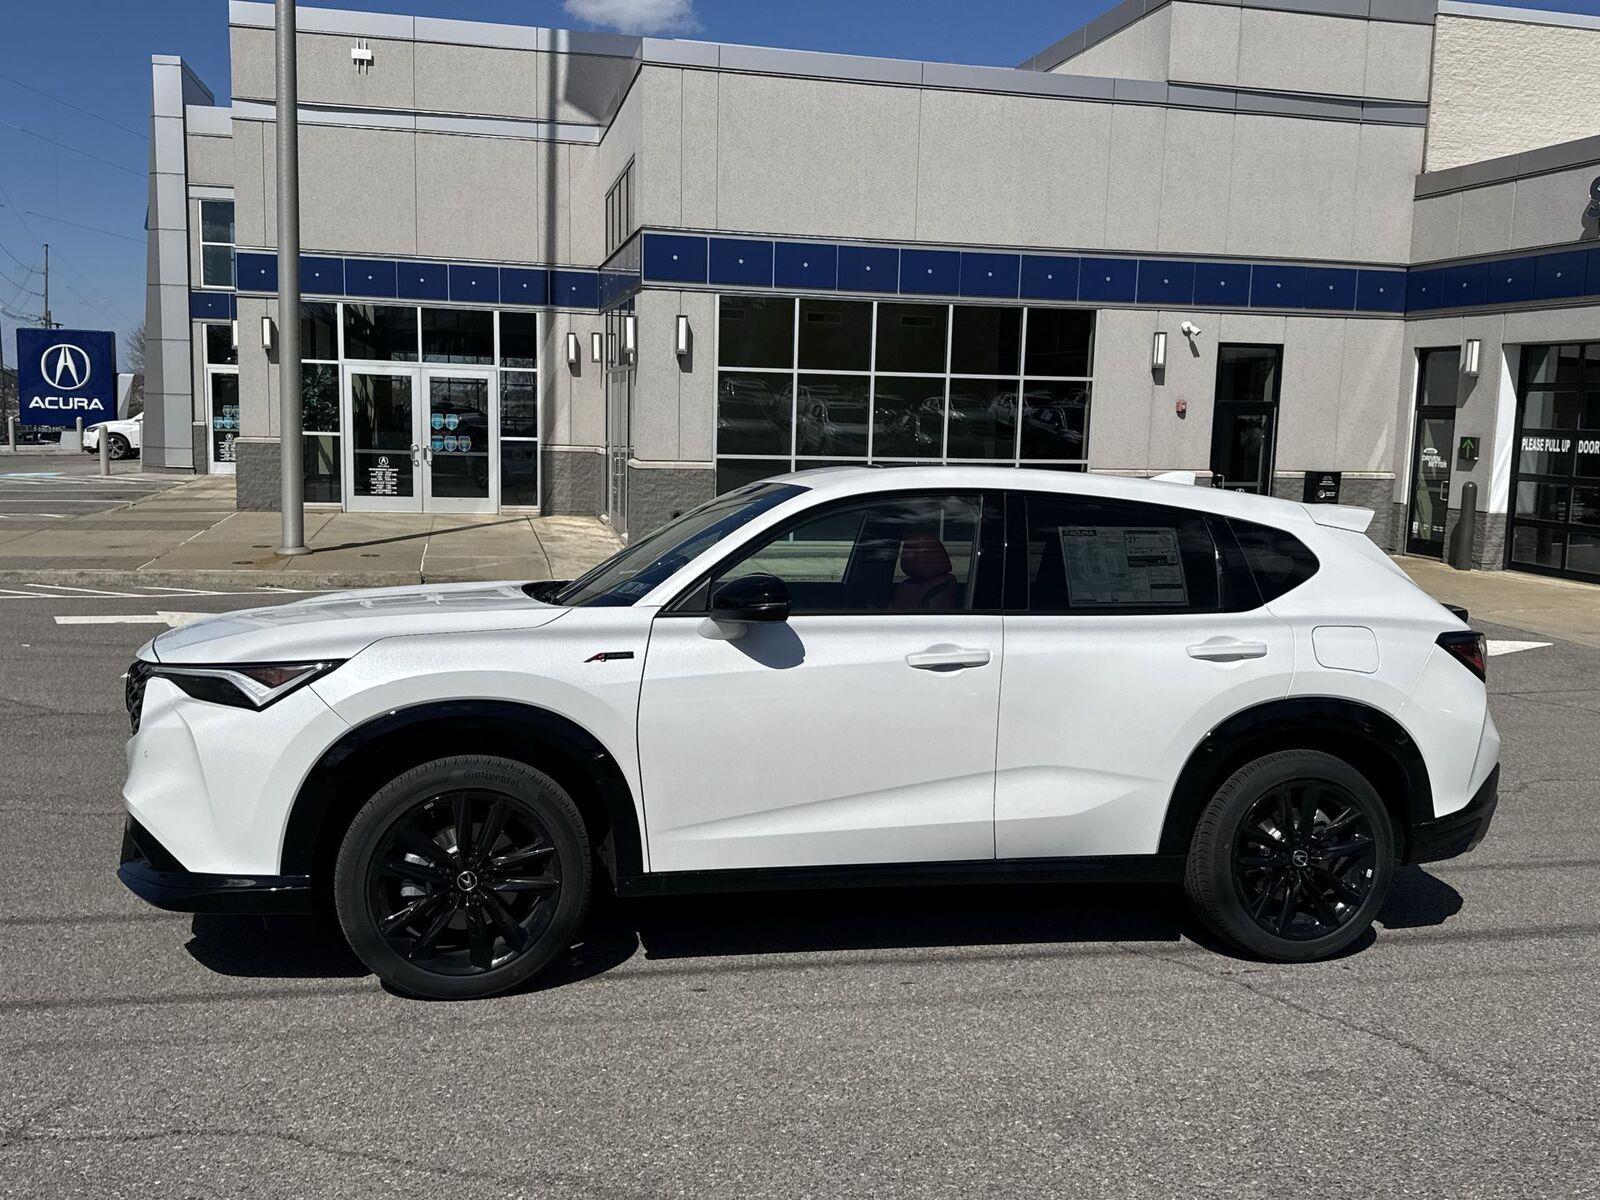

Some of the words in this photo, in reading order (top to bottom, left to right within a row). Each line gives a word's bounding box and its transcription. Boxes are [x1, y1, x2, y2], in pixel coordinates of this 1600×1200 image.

[28, 396, 104, 410] ACURA
[1521, 437, 1544, 451] PLEASE
[1545, 438, 1560, 453] PULL
[1561, 439, 1570, 452] UP
[1578, 440, 1600, 454] DOOR
[464, 770, 520, 785] Continental
